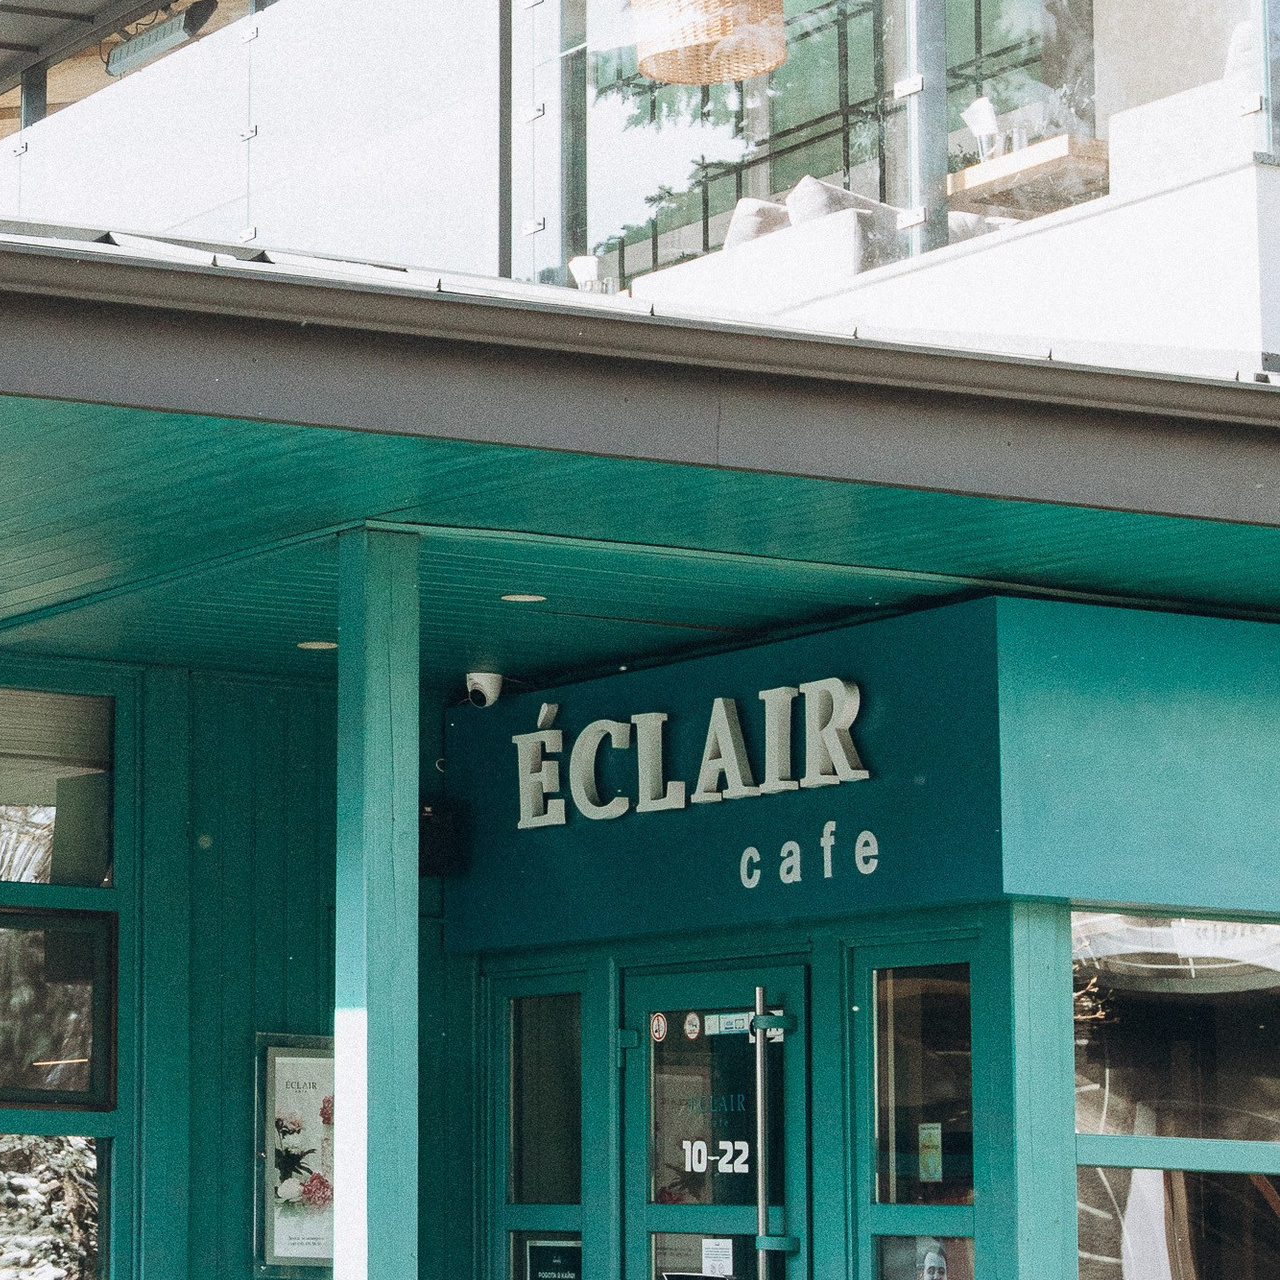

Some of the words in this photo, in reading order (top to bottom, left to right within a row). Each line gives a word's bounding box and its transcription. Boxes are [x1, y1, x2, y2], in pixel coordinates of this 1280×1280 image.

[512, 677, 870, 830] ÉCLAIR
[739, 819, 880, 889] cafe
[682, 1141, 750, 1173] 10-22
